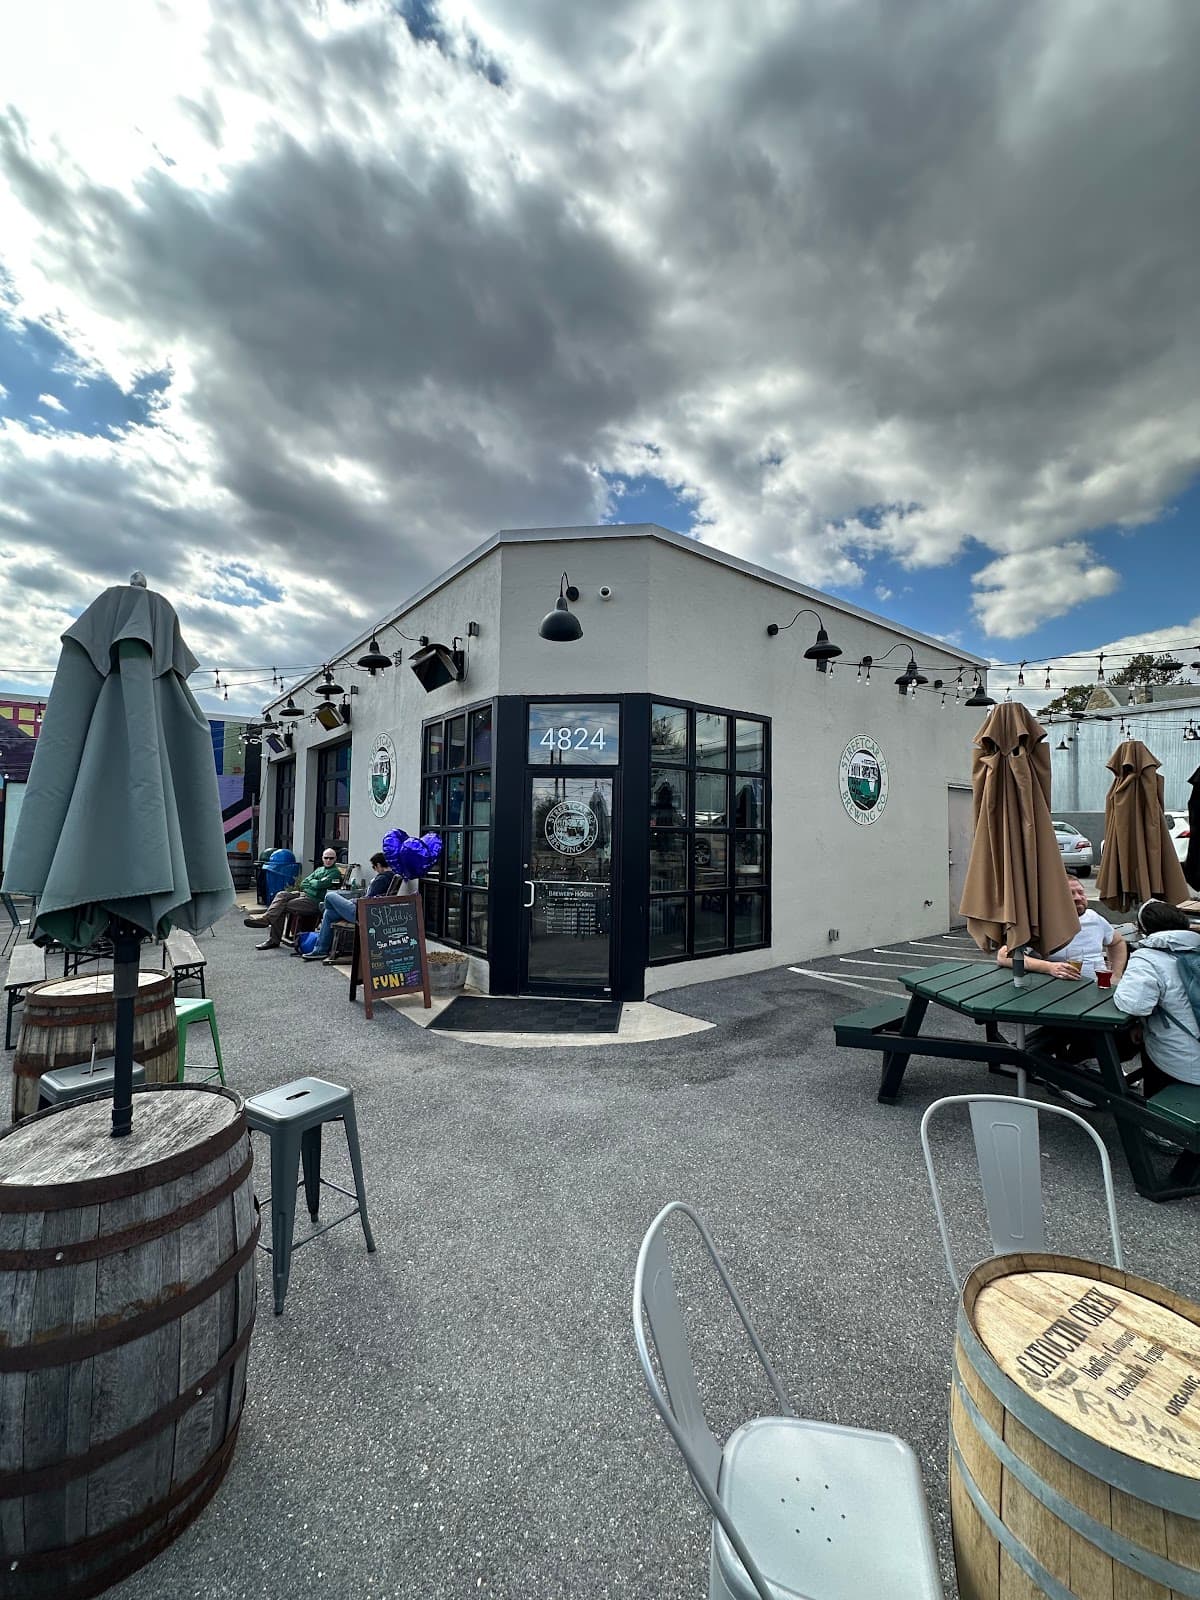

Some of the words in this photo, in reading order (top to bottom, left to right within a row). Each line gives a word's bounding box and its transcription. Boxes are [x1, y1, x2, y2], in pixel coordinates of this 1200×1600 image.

[540, 727, 606, 751] 4824
[842, 738, 880, 770] STREETCAR
[548, 803, 590, 824] STREETCAR
[842, 791, 876, 823] BREWING
[549, 834, 582, 853] BREWING
[372, 972, 405, 990] FUN!
[1016, 1315, 1091, 1379] CATOCTIN
[1068, 1286, 1122, 1327] CREEK
[1080, 1353, 1118, 1380] Distilling
[1102, 1329, 1140, 1356] Company
[1133, 1338, 1167, 1366] Virginia
[1165, 1374, 1200, 1417] ORGANIC
